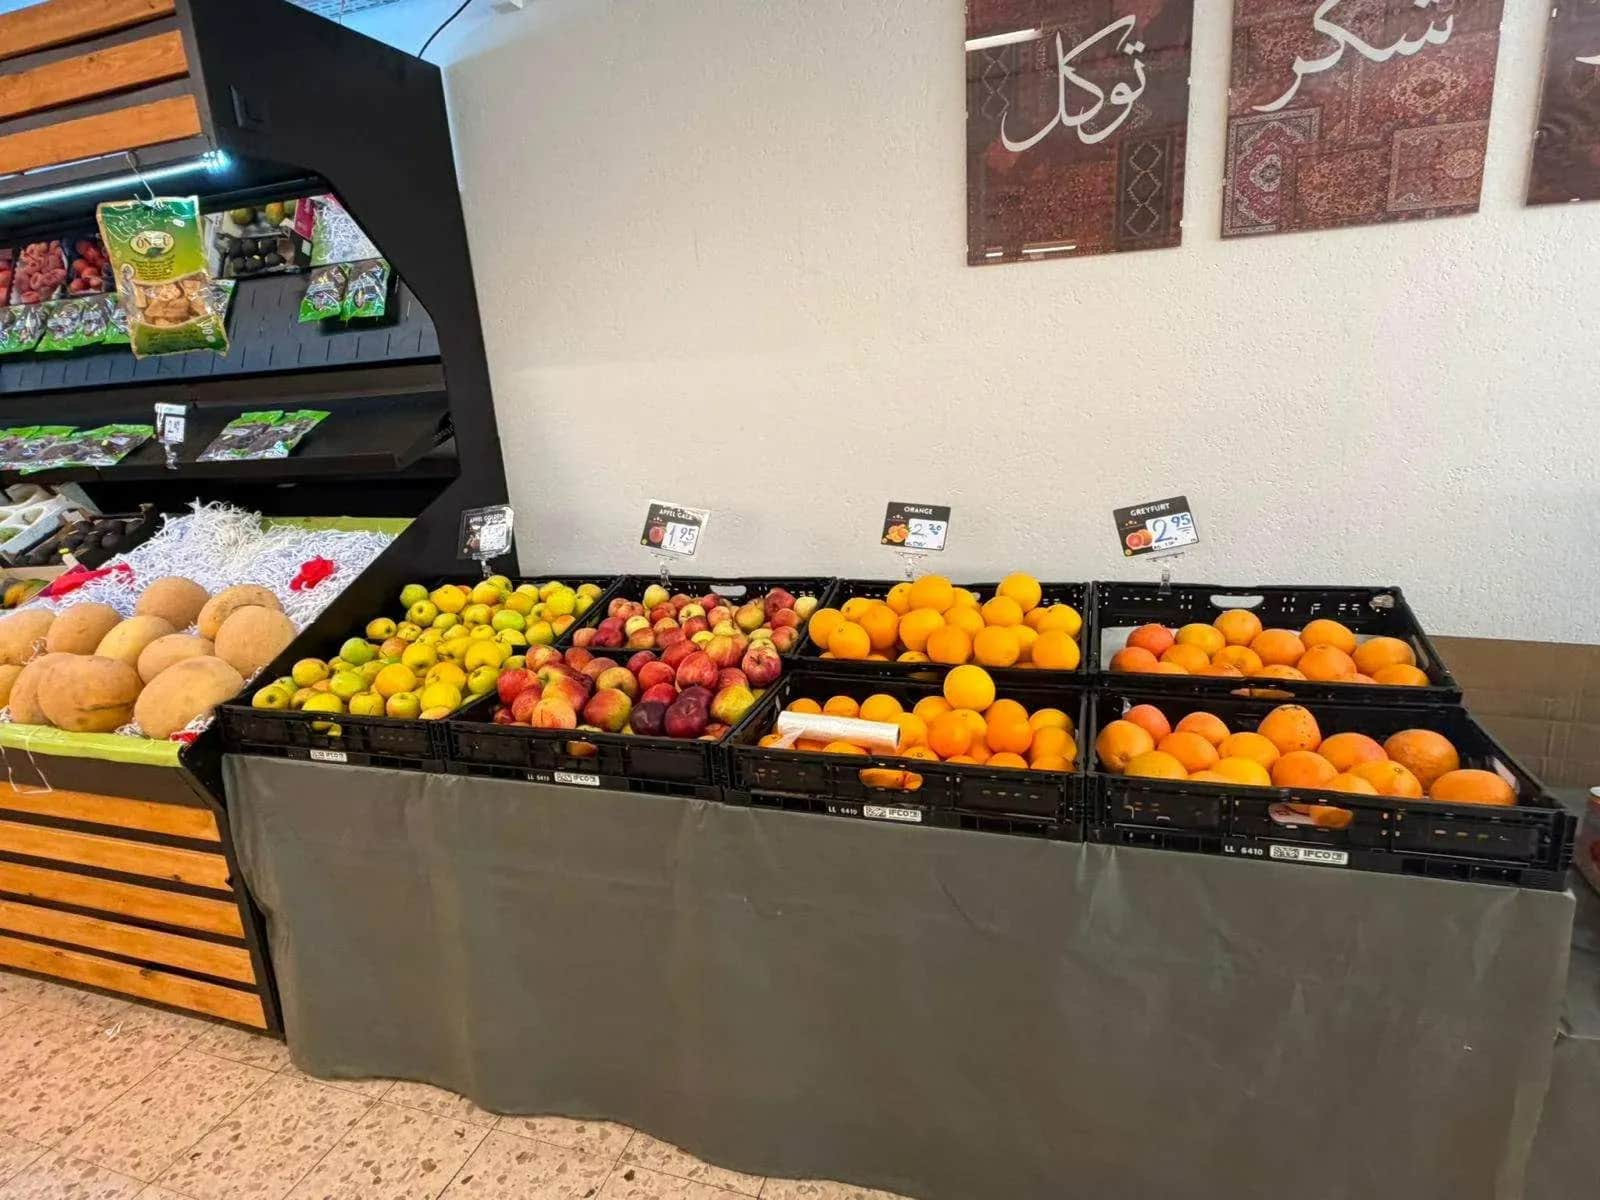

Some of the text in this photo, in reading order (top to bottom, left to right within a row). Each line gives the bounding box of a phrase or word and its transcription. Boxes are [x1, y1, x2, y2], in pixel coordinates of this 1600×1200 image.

[1000, 14, 1147, 153] توكل
[903, 506, 933, 515] ORANGE
[1130, 502, 1170, 517] GREYFURT
[1224, 845, 1263, 856] LL 6410
[1303, 849, 1332, 859] IFCO
